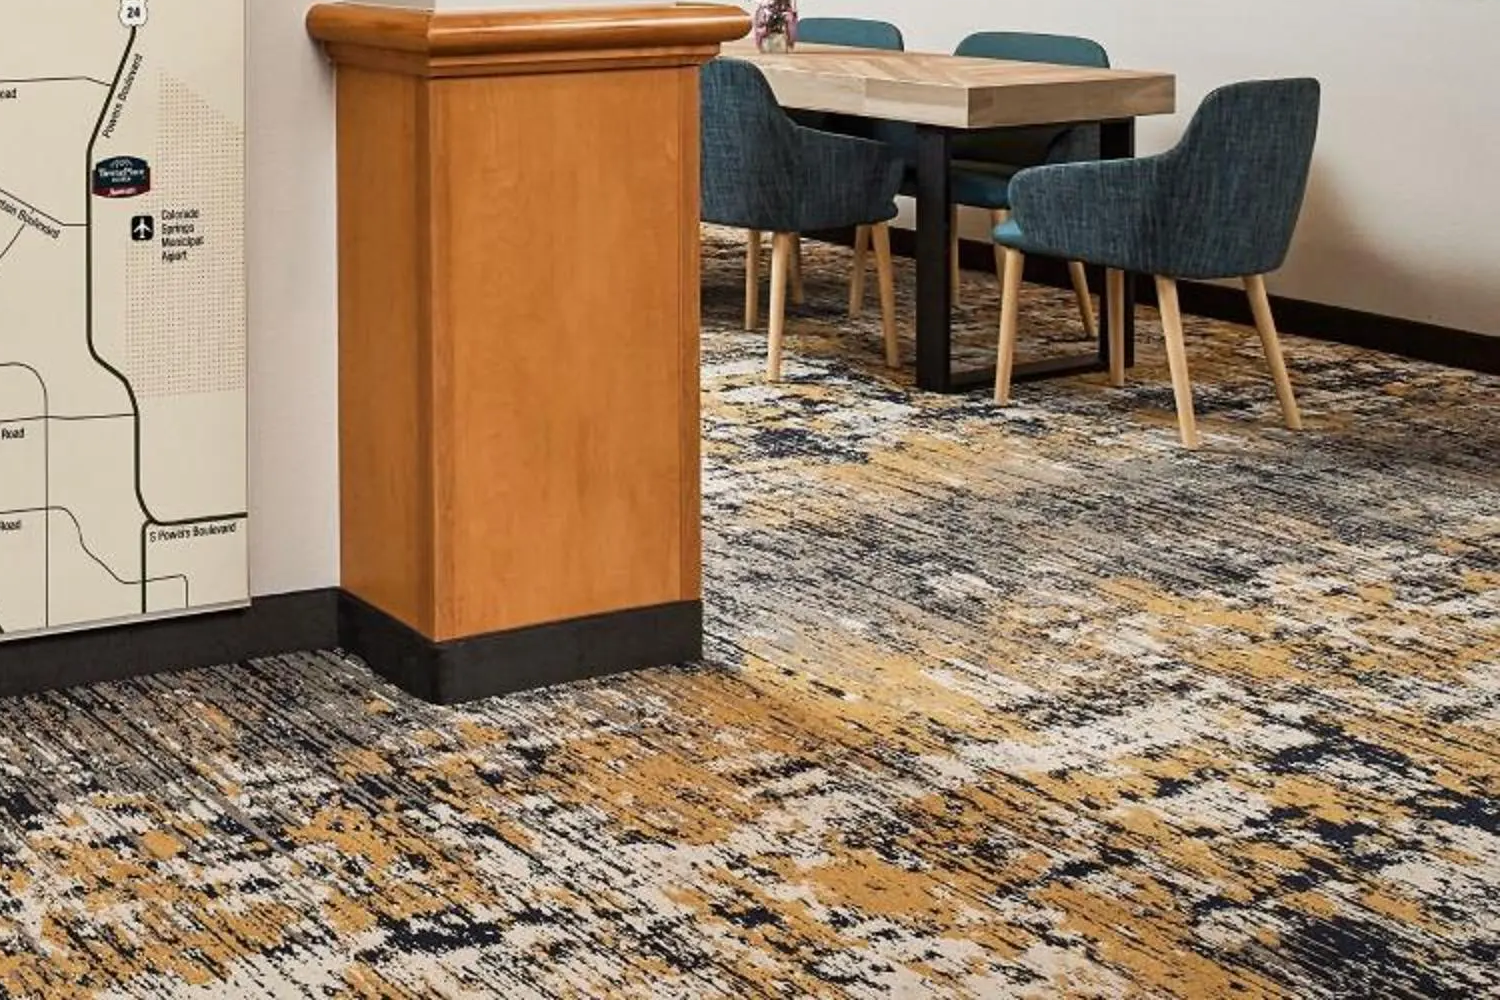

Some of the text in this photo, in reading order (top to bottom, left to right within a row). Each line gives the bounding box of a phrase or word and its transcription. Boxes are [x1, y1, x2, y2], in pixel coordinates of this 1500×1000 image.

[127, 6, 140, 18] 24
[102, 53, 143, 138] Powers Boulevard
[1, 428, 25, 441] Road
[150, 522, 237, 542] S Powers Boulevard
